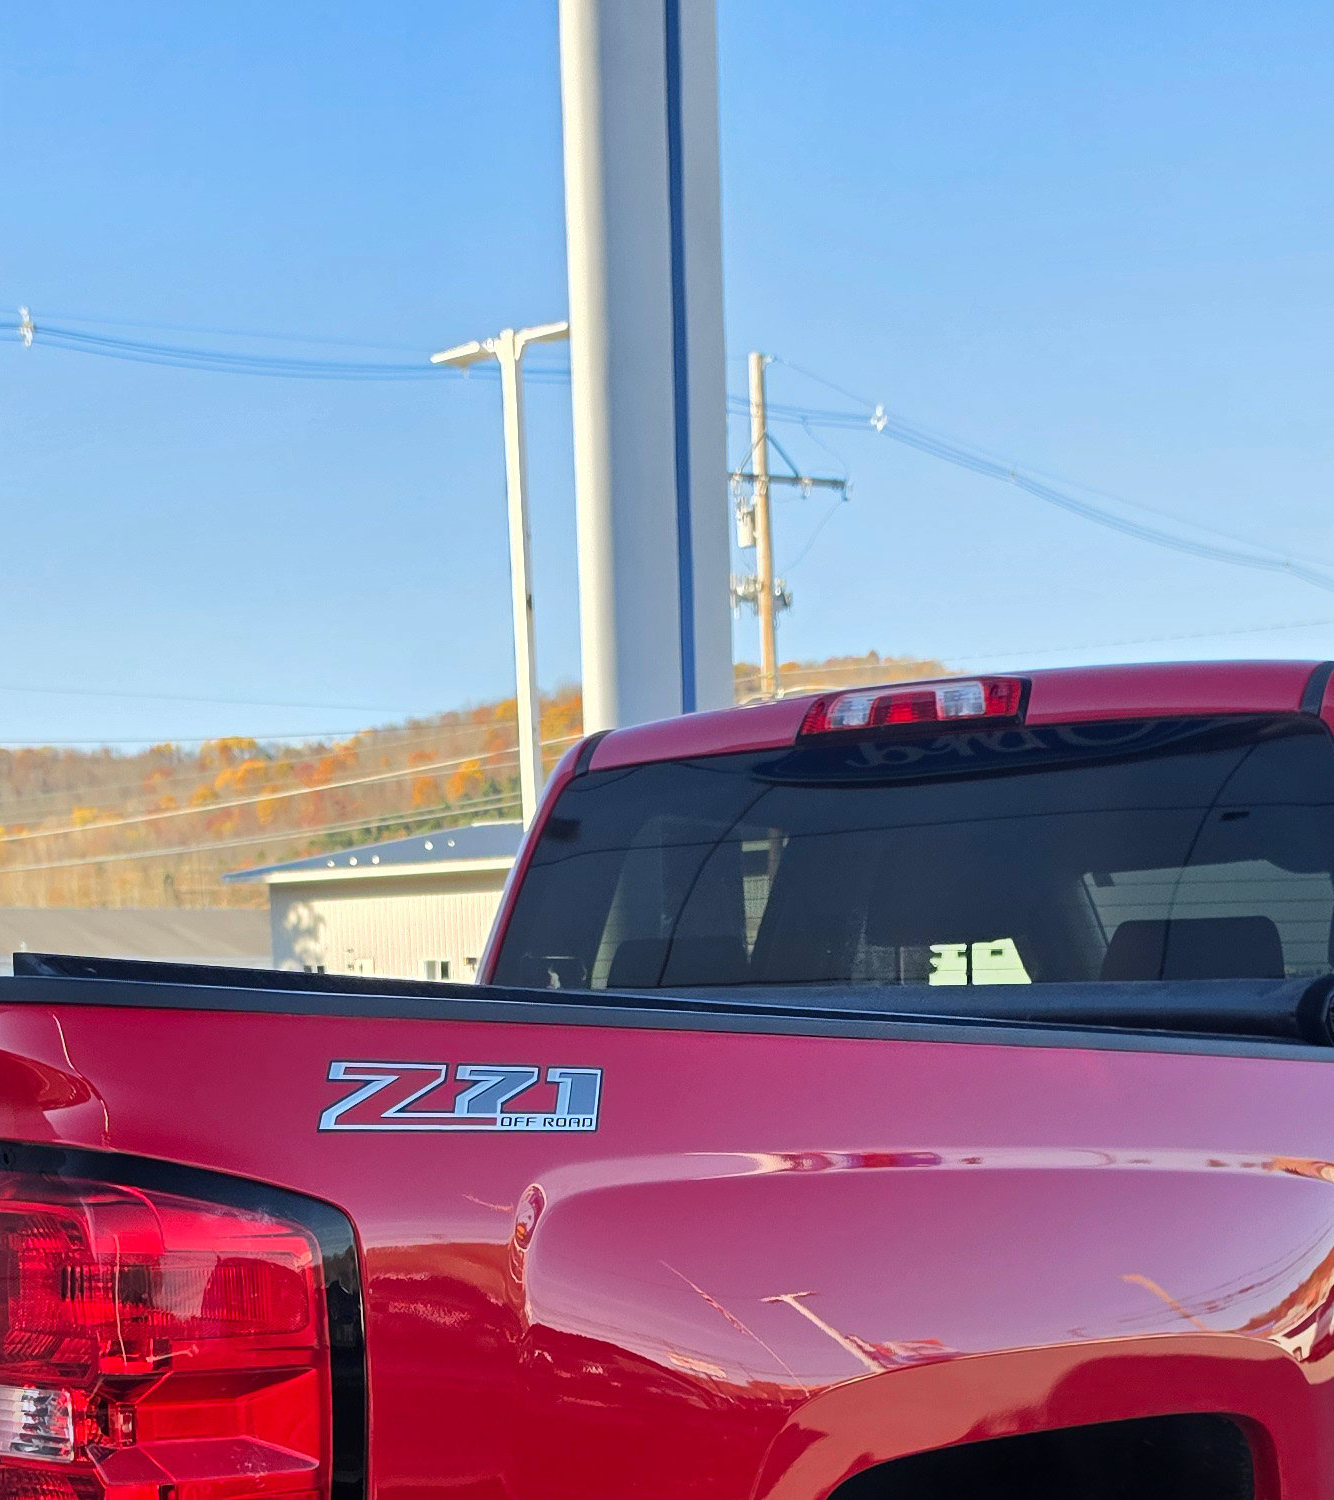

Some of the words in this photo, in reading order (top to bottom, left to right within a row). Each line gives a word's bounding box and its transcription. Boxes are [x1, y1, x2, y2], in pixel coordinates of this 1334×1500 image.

[317, 1061, 603, 1132] Z71
[500, 1116, 537, 1127] OFF
[543, 1117, 594, 1128] ROAD
